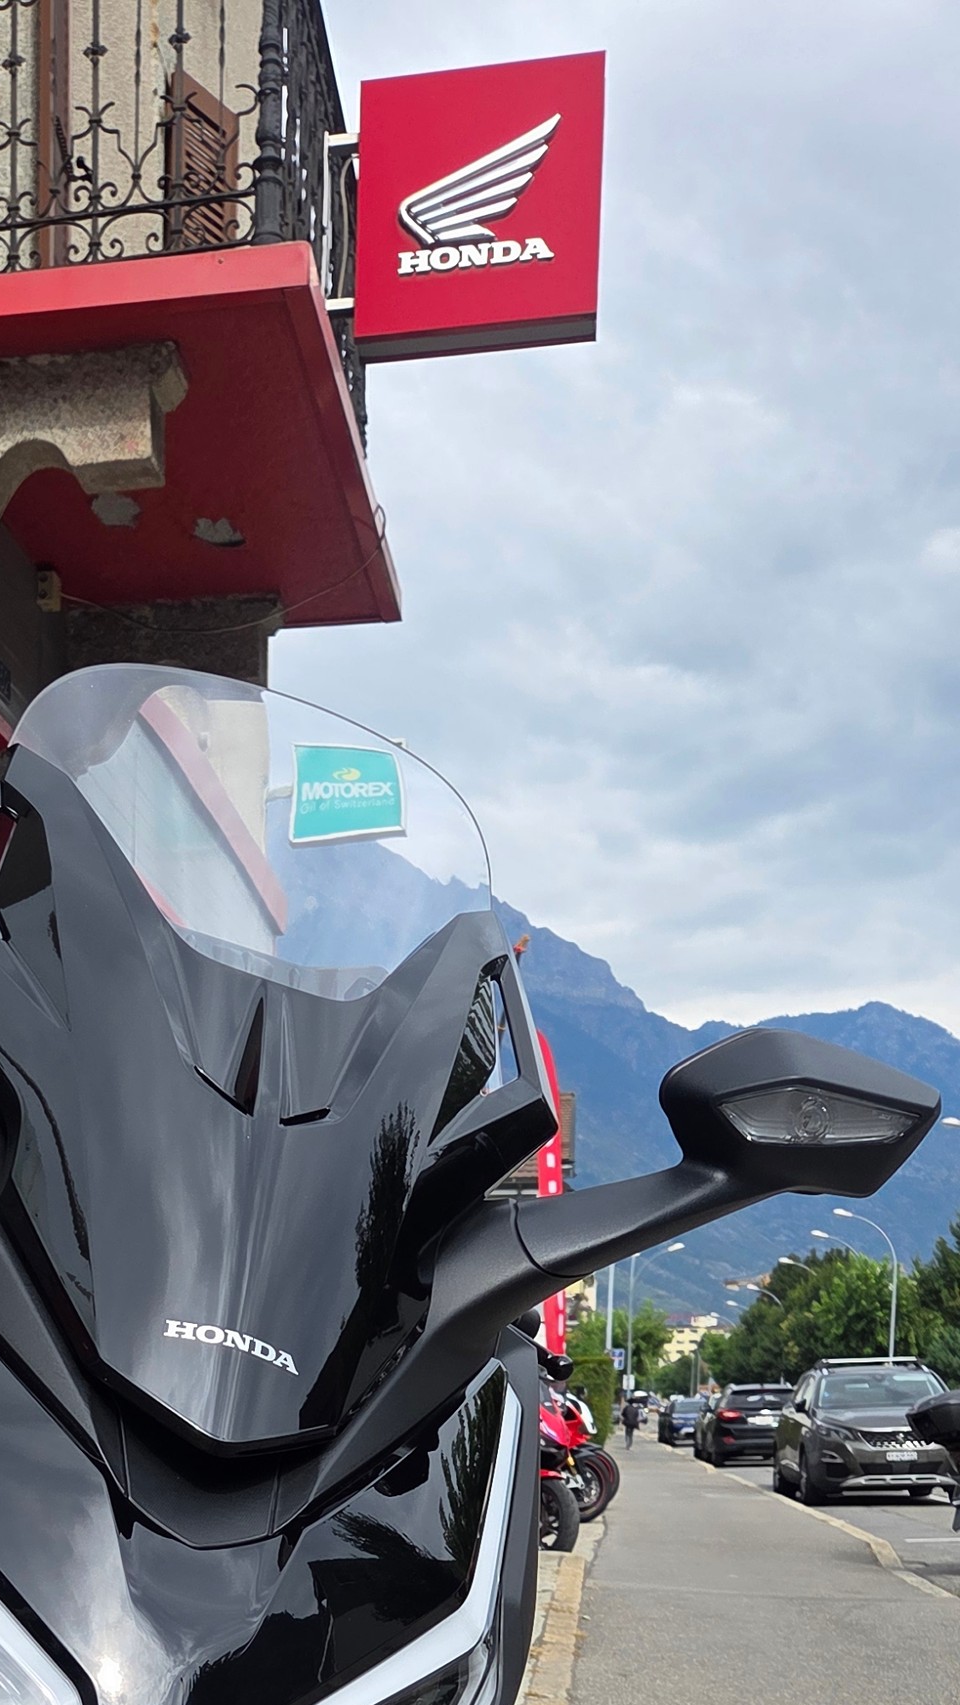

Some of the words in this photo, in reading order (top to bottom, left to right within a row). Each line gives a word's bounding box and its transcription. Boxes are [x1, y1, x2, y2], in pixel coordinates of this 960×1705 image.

[397, 237, 554, 275] HONDA
[301, 781, 394, 802] MOTOREX
[163, 1319, 299, 1376] HONDA
